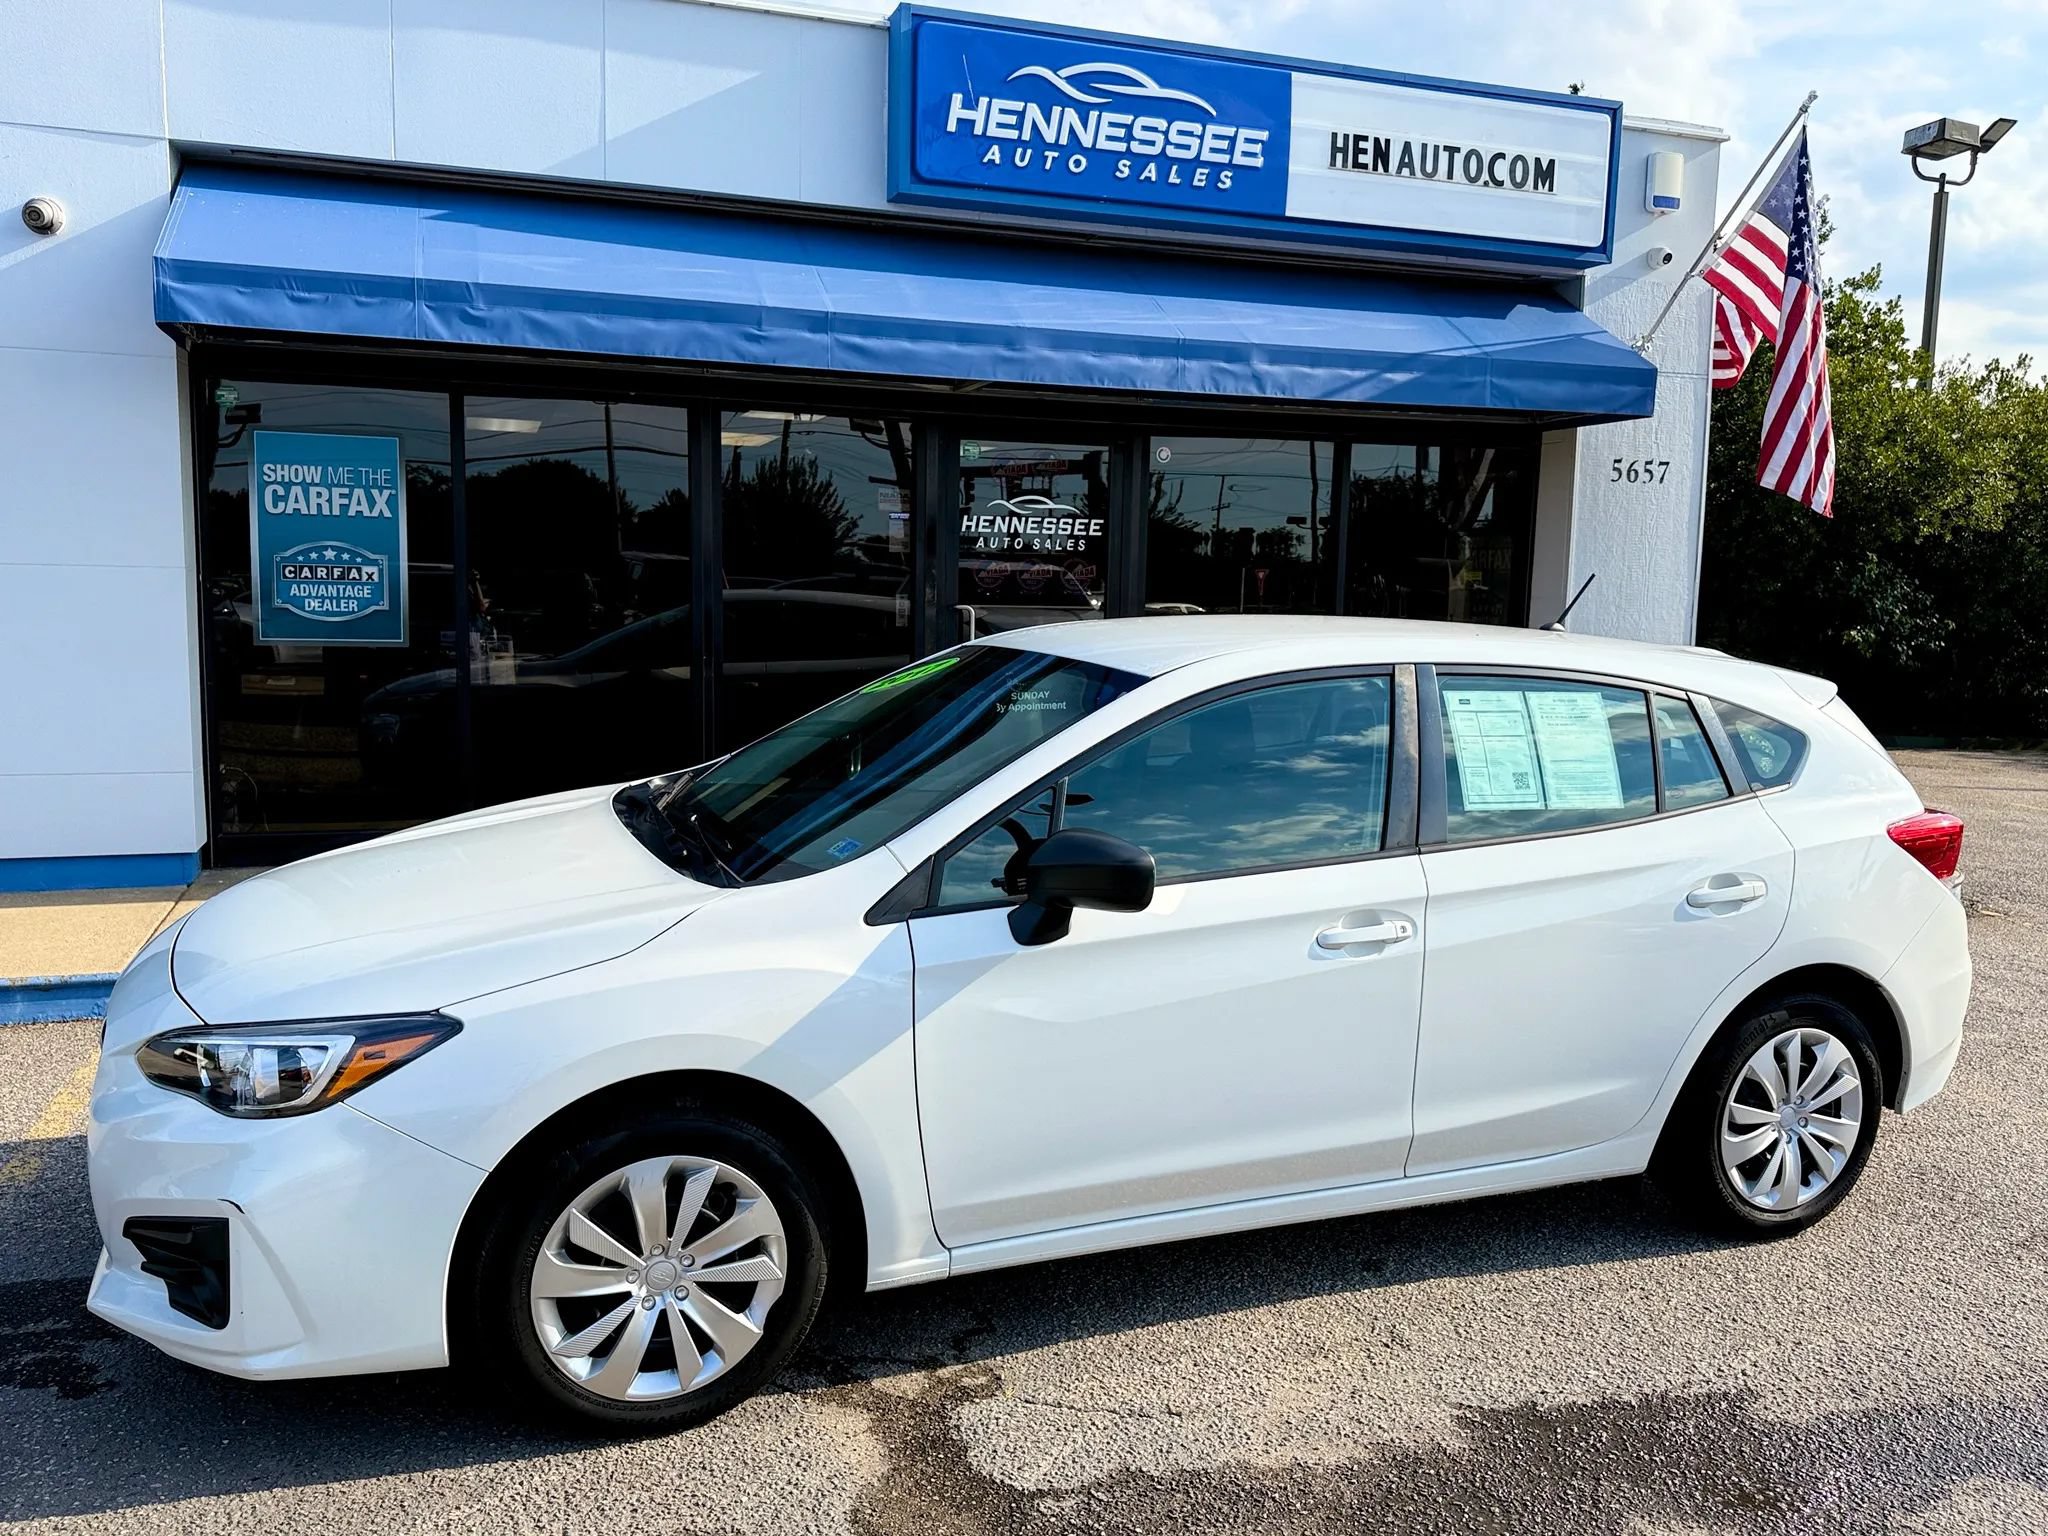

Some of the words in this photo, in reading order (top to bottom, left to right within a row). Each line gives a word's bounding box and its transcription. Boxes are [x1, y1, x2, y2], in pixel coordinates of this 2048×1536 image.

[946, 92, 1269, 168] HENNESSEE
[982, 144, 1088, 174] AUTO
[1115, 159, 1234, 190] SALES
[1329, 131, 1556, 193] HENAUTO.COM
[262, 463, 322, 484] SHOW
[327, 466, 355, 485] ME
[358, 467, 392, 487] THE
[1611, 457, 1670, 484] 5657
[264, 484, 393, 518] CARFAX
[961, 515, 1104, 536] HENNESSEE
[975, 537, 1024, 549] AUTO
[1032, 538, 1086, 551] SALES
[284, 566, 376, 582] CARFAX
[289, 584, 373, 598] ADVANTAGE
[304, 599, 359, 612] DEALER
[1010, 690, 1050, 701] SUNDAY
[1007, 701, 1067, 712] Appointment
